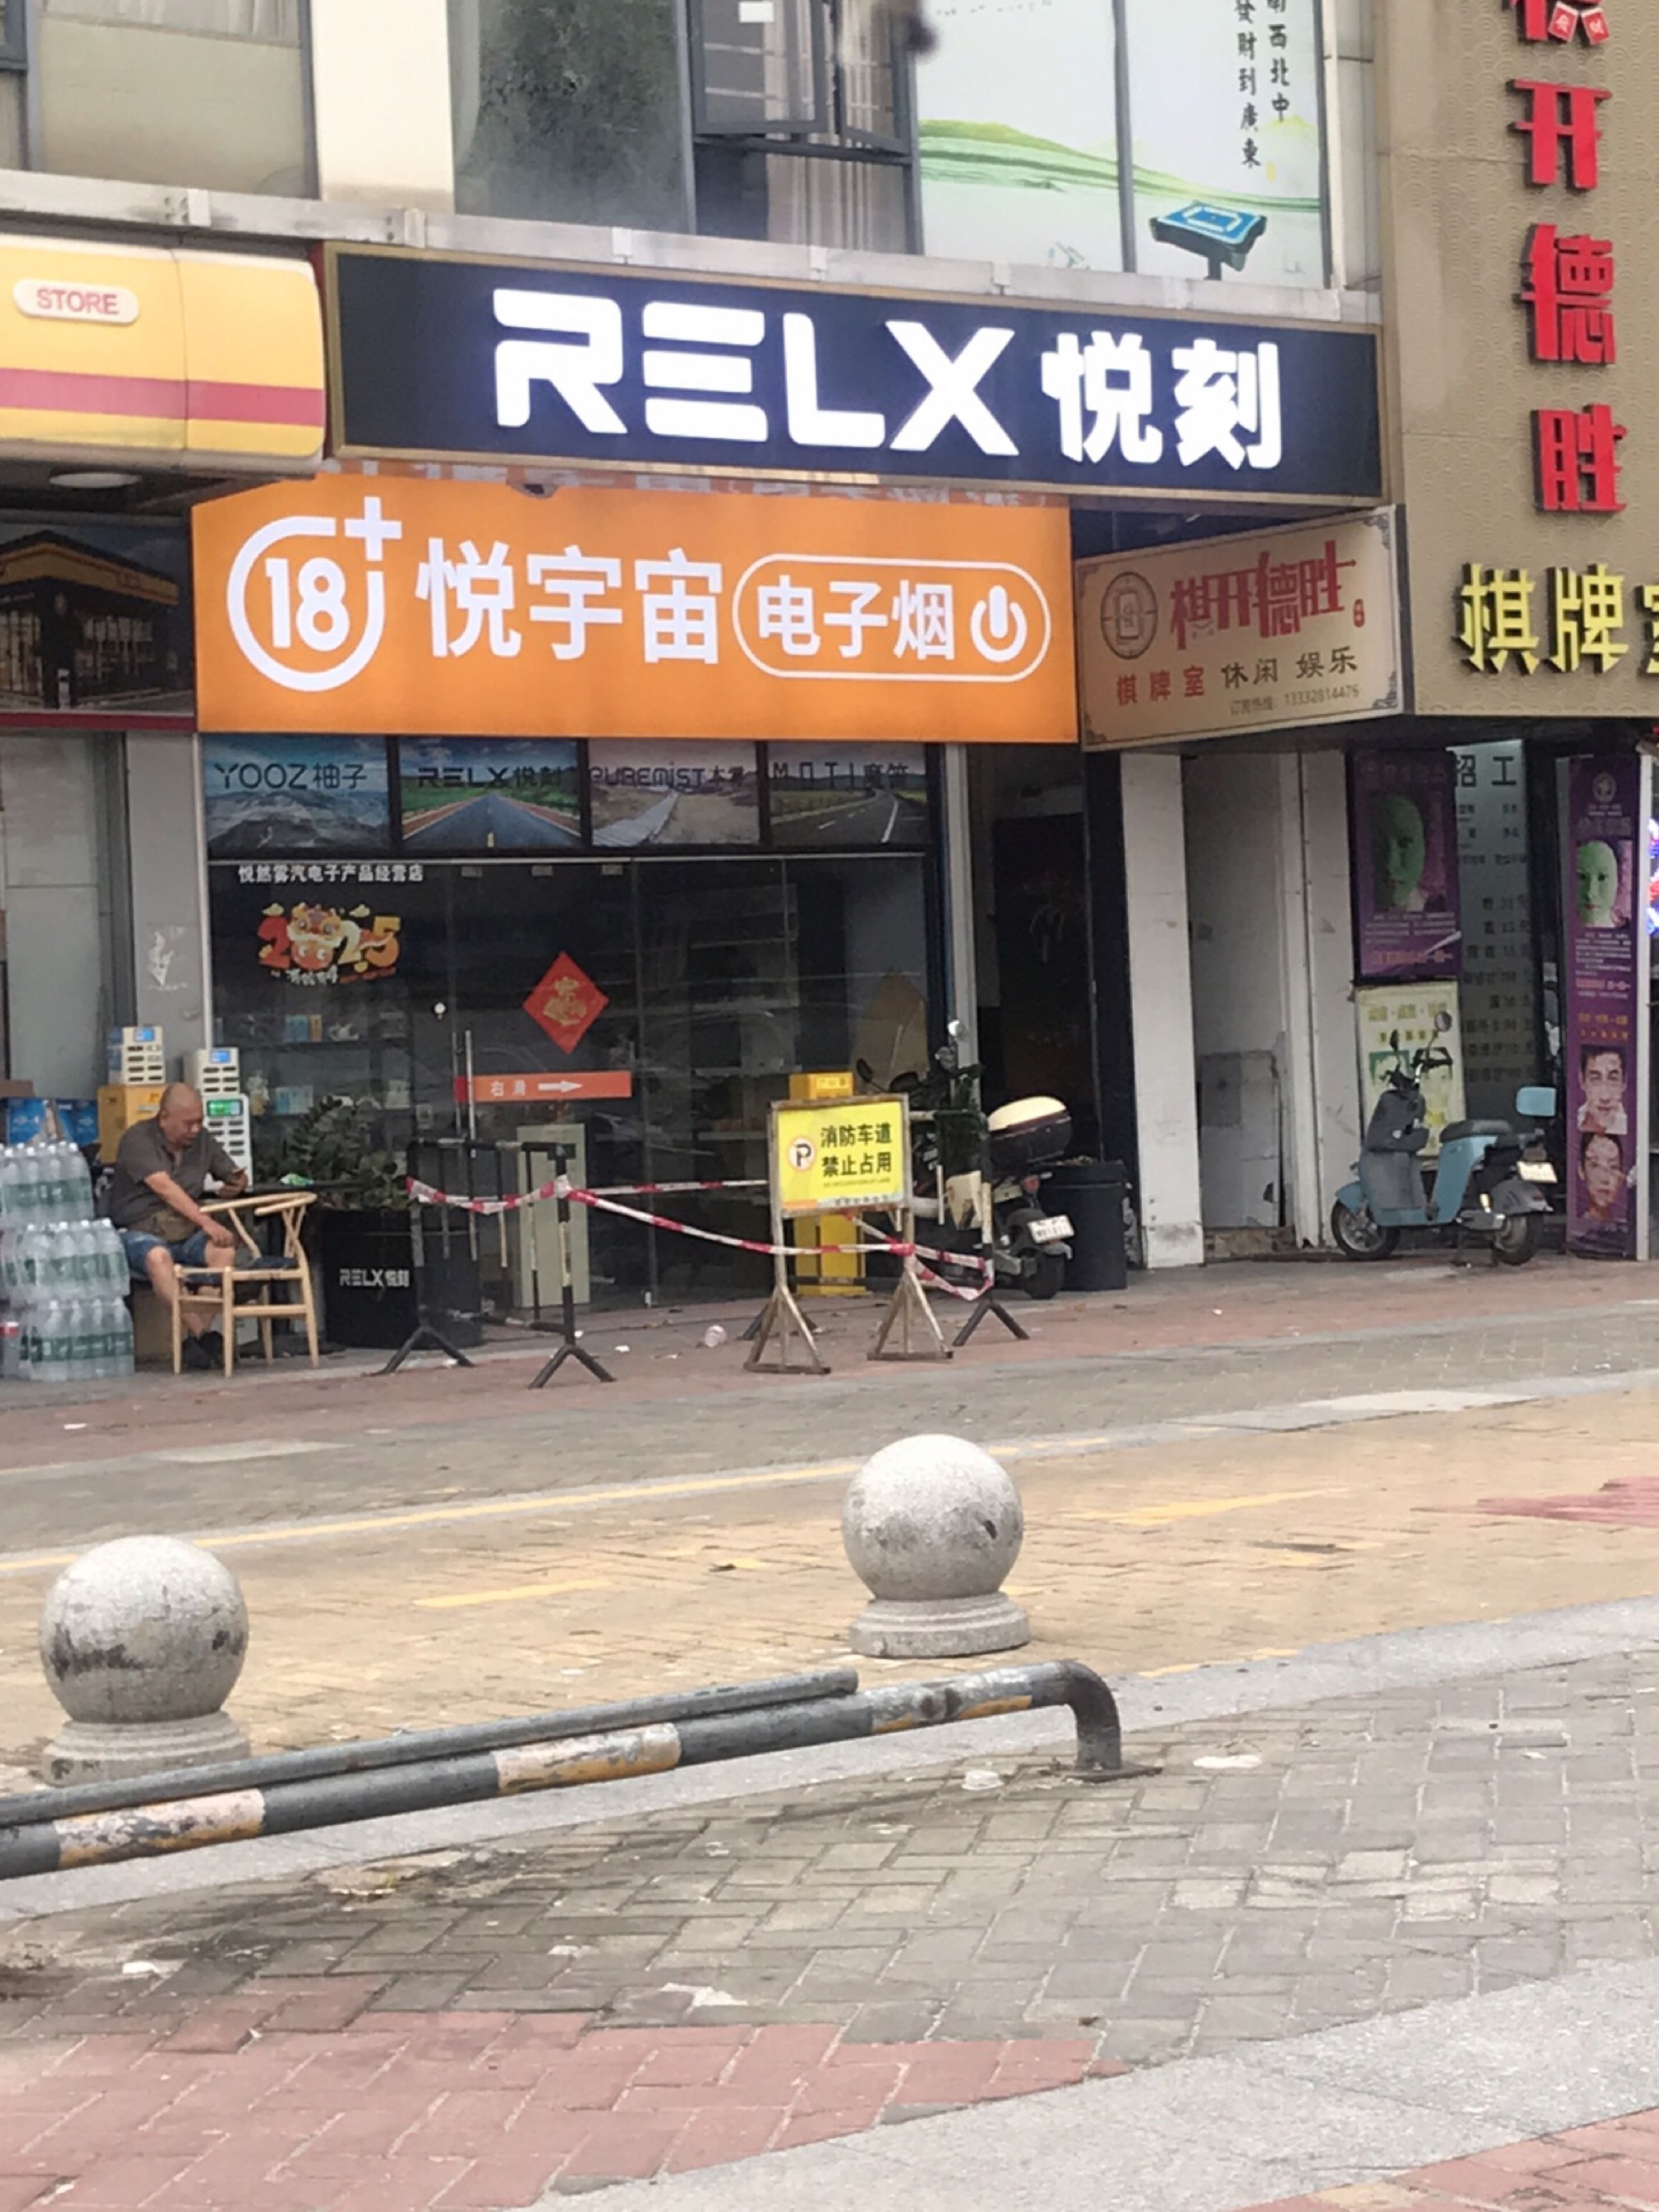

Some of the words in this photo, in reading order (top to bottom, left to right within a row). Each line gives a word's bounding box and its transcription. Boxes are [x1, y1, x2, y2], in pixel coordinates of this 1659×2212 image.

[36, 288, 120, 315] STORE
[493, 288, 1019, 456] RELX
[1041, 330, 1282, 470] 悦刻
[415, 536, 723, 664] 悦宇宙
[757, 574, 956, 661] 电子烟
[1459, 563, 1659, 676] 棋牌
[1116, 664, 1205, 707] 棋牌室
[1221, 657, 1278, 689] 休闲
[1295, 646, 1358, 679] 娱乐
[214, 764, 308, 790] YOOZ
[312, 764, 367, 789] 柚子
[418, 766, 509, 788] RELX
[820, 1121, 894, 1148] 消防车道
[821, 1151, 892, 1178] 禁止占用
[339, 1269, 384, 1287] RELX
